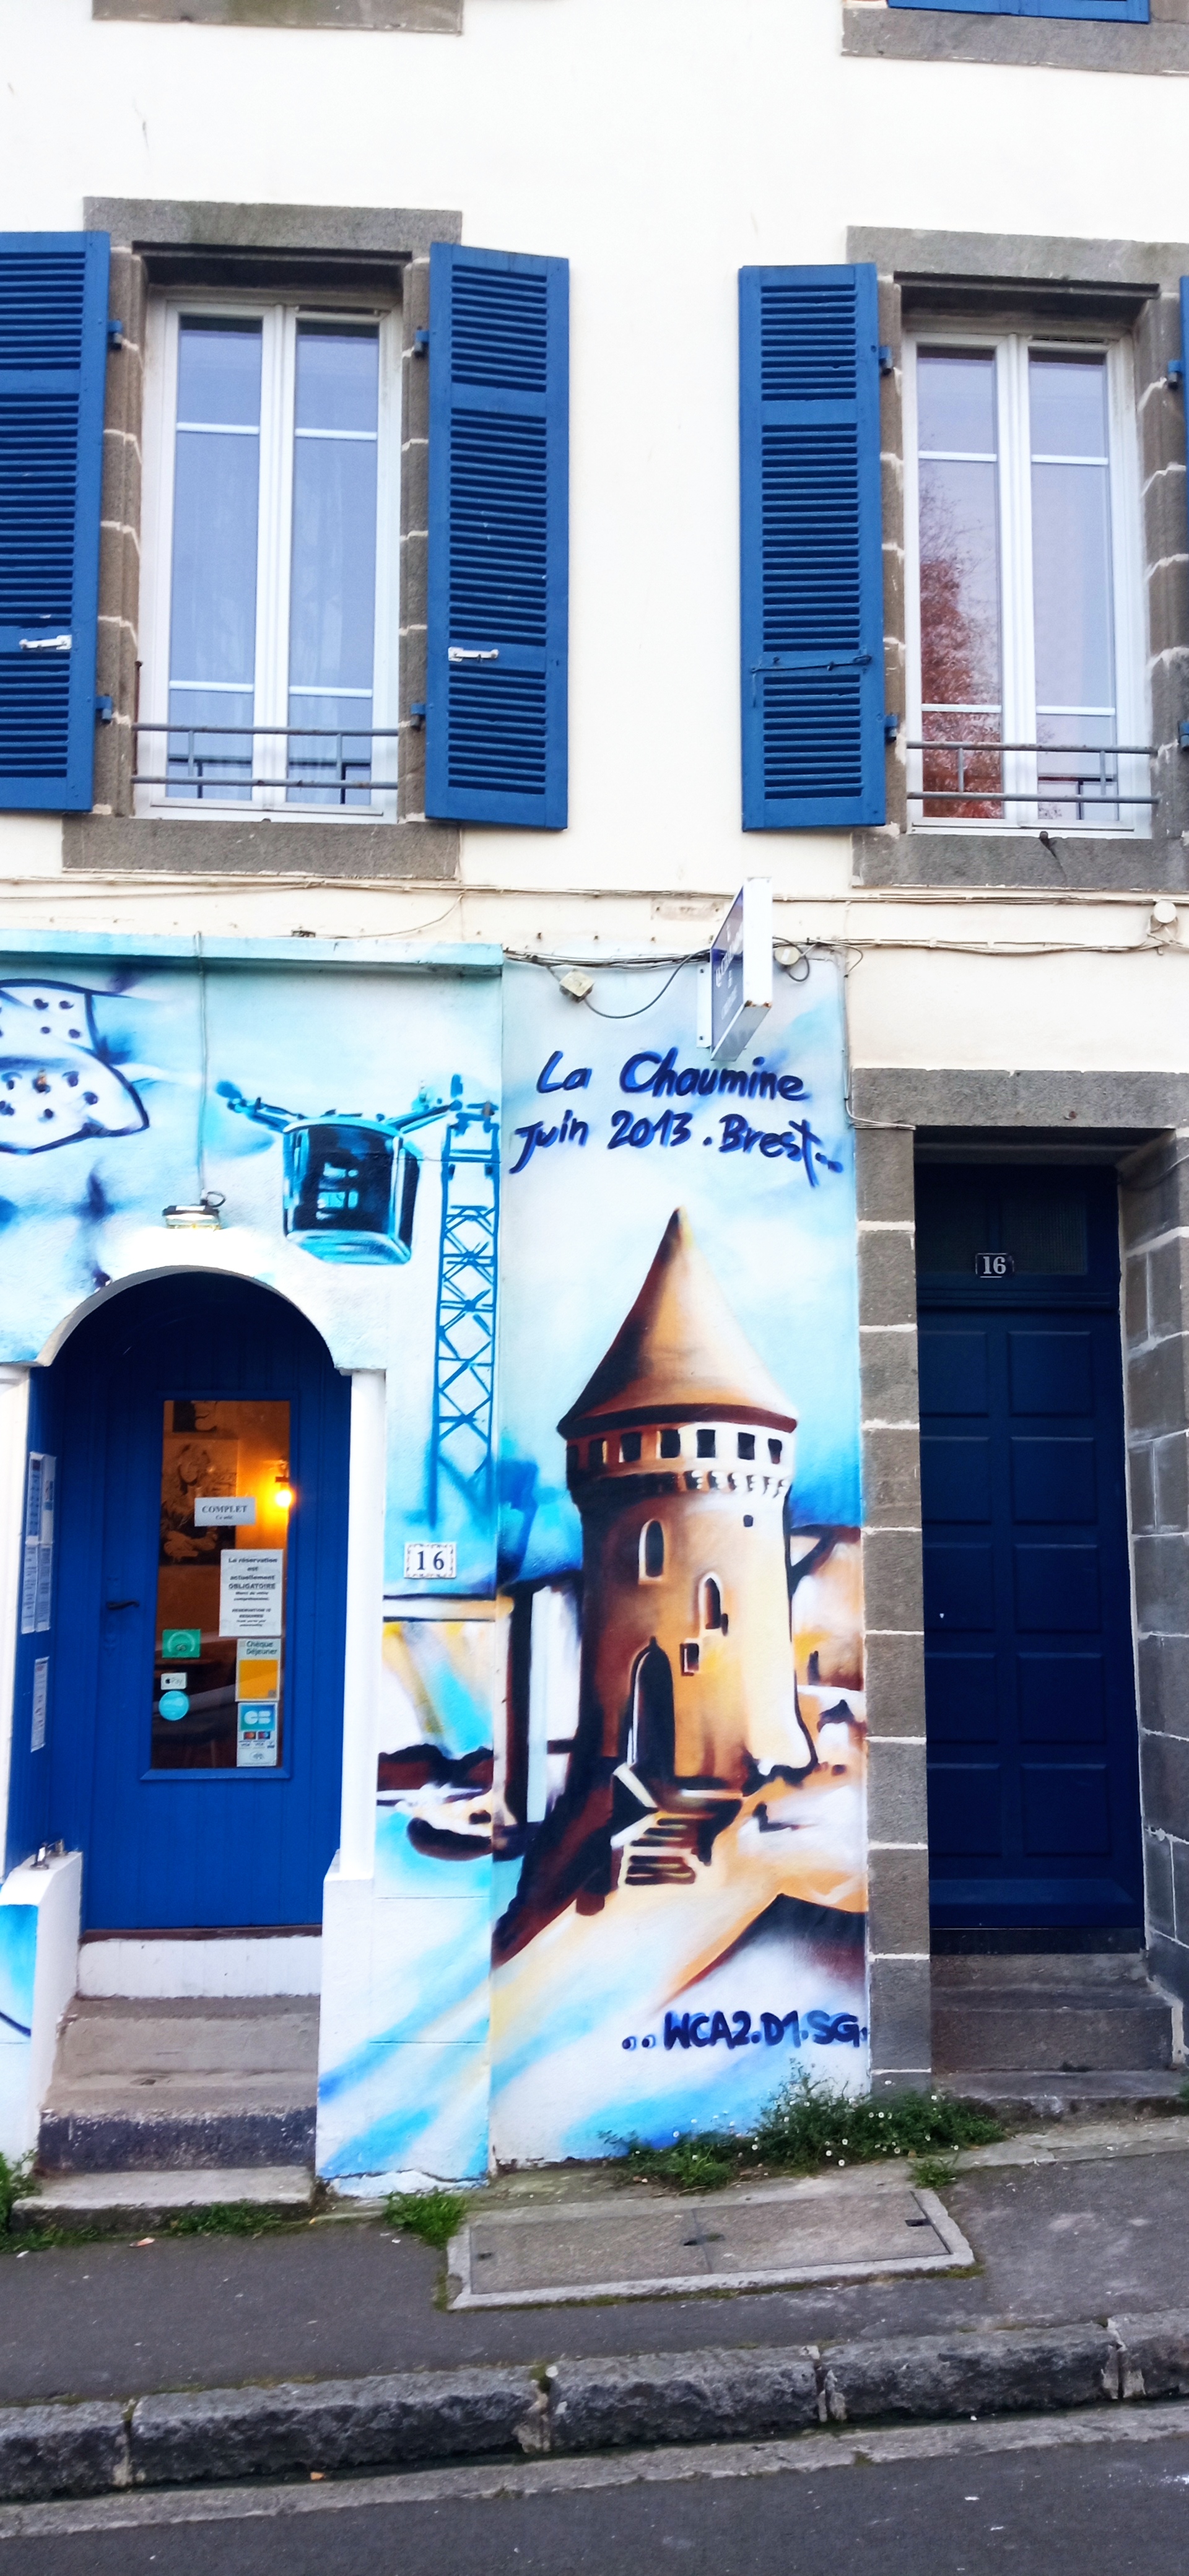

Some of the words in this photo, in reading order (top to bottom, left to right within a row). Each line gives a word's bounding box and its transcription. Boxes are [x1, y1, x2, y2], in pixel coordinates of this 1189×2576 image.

[536, 1050, 593, 1094] La
[619, 1046, 811, 1102] Chaumine
[509, 1110, 591, 1174] Juin
[607, 1110, 692, 1150] 2013
[983, 1256, 1006, 1274] 16
[417, 1550, 445, 1570] 16
[244, 1710, 271, 1725] CB
